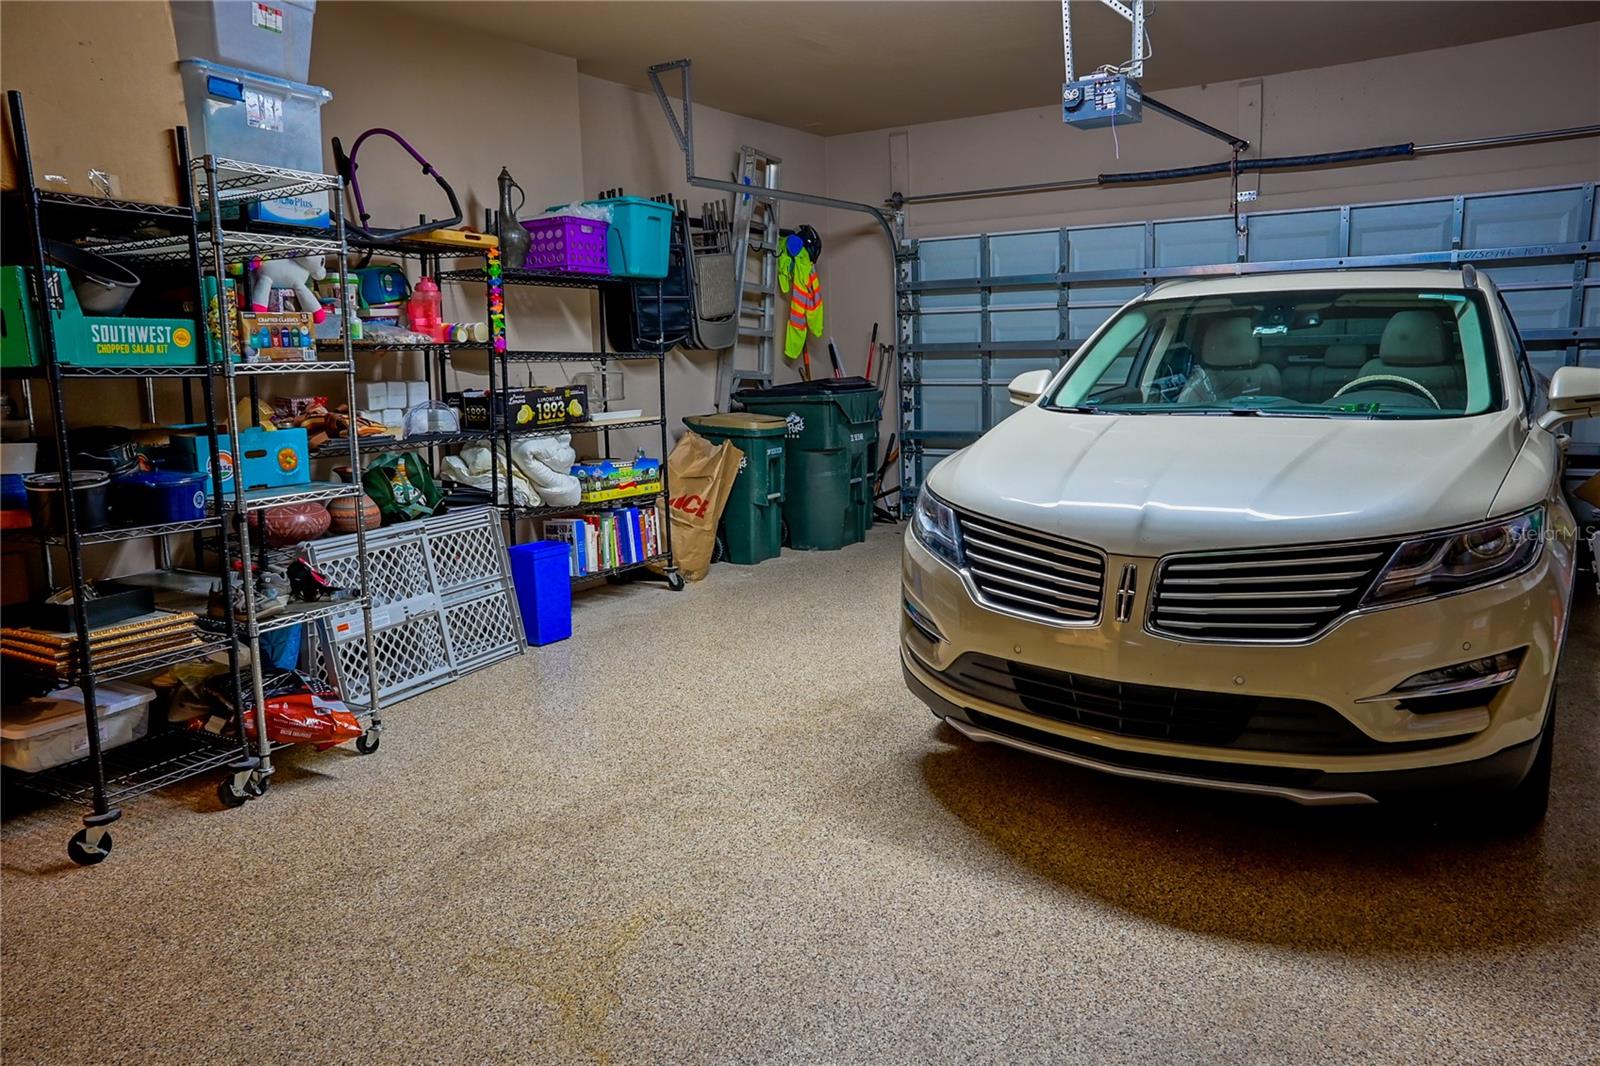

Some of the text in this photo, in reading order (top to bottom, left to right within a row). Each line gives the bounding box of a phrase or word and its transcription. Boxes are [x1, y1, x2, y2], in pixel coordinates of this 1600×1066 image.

[91, 324, 171, 343] SOUTHWEST
[96, 344, 168, 354] CHOPPED SALAD KIT
[536, 401, 565, 420] 1893
